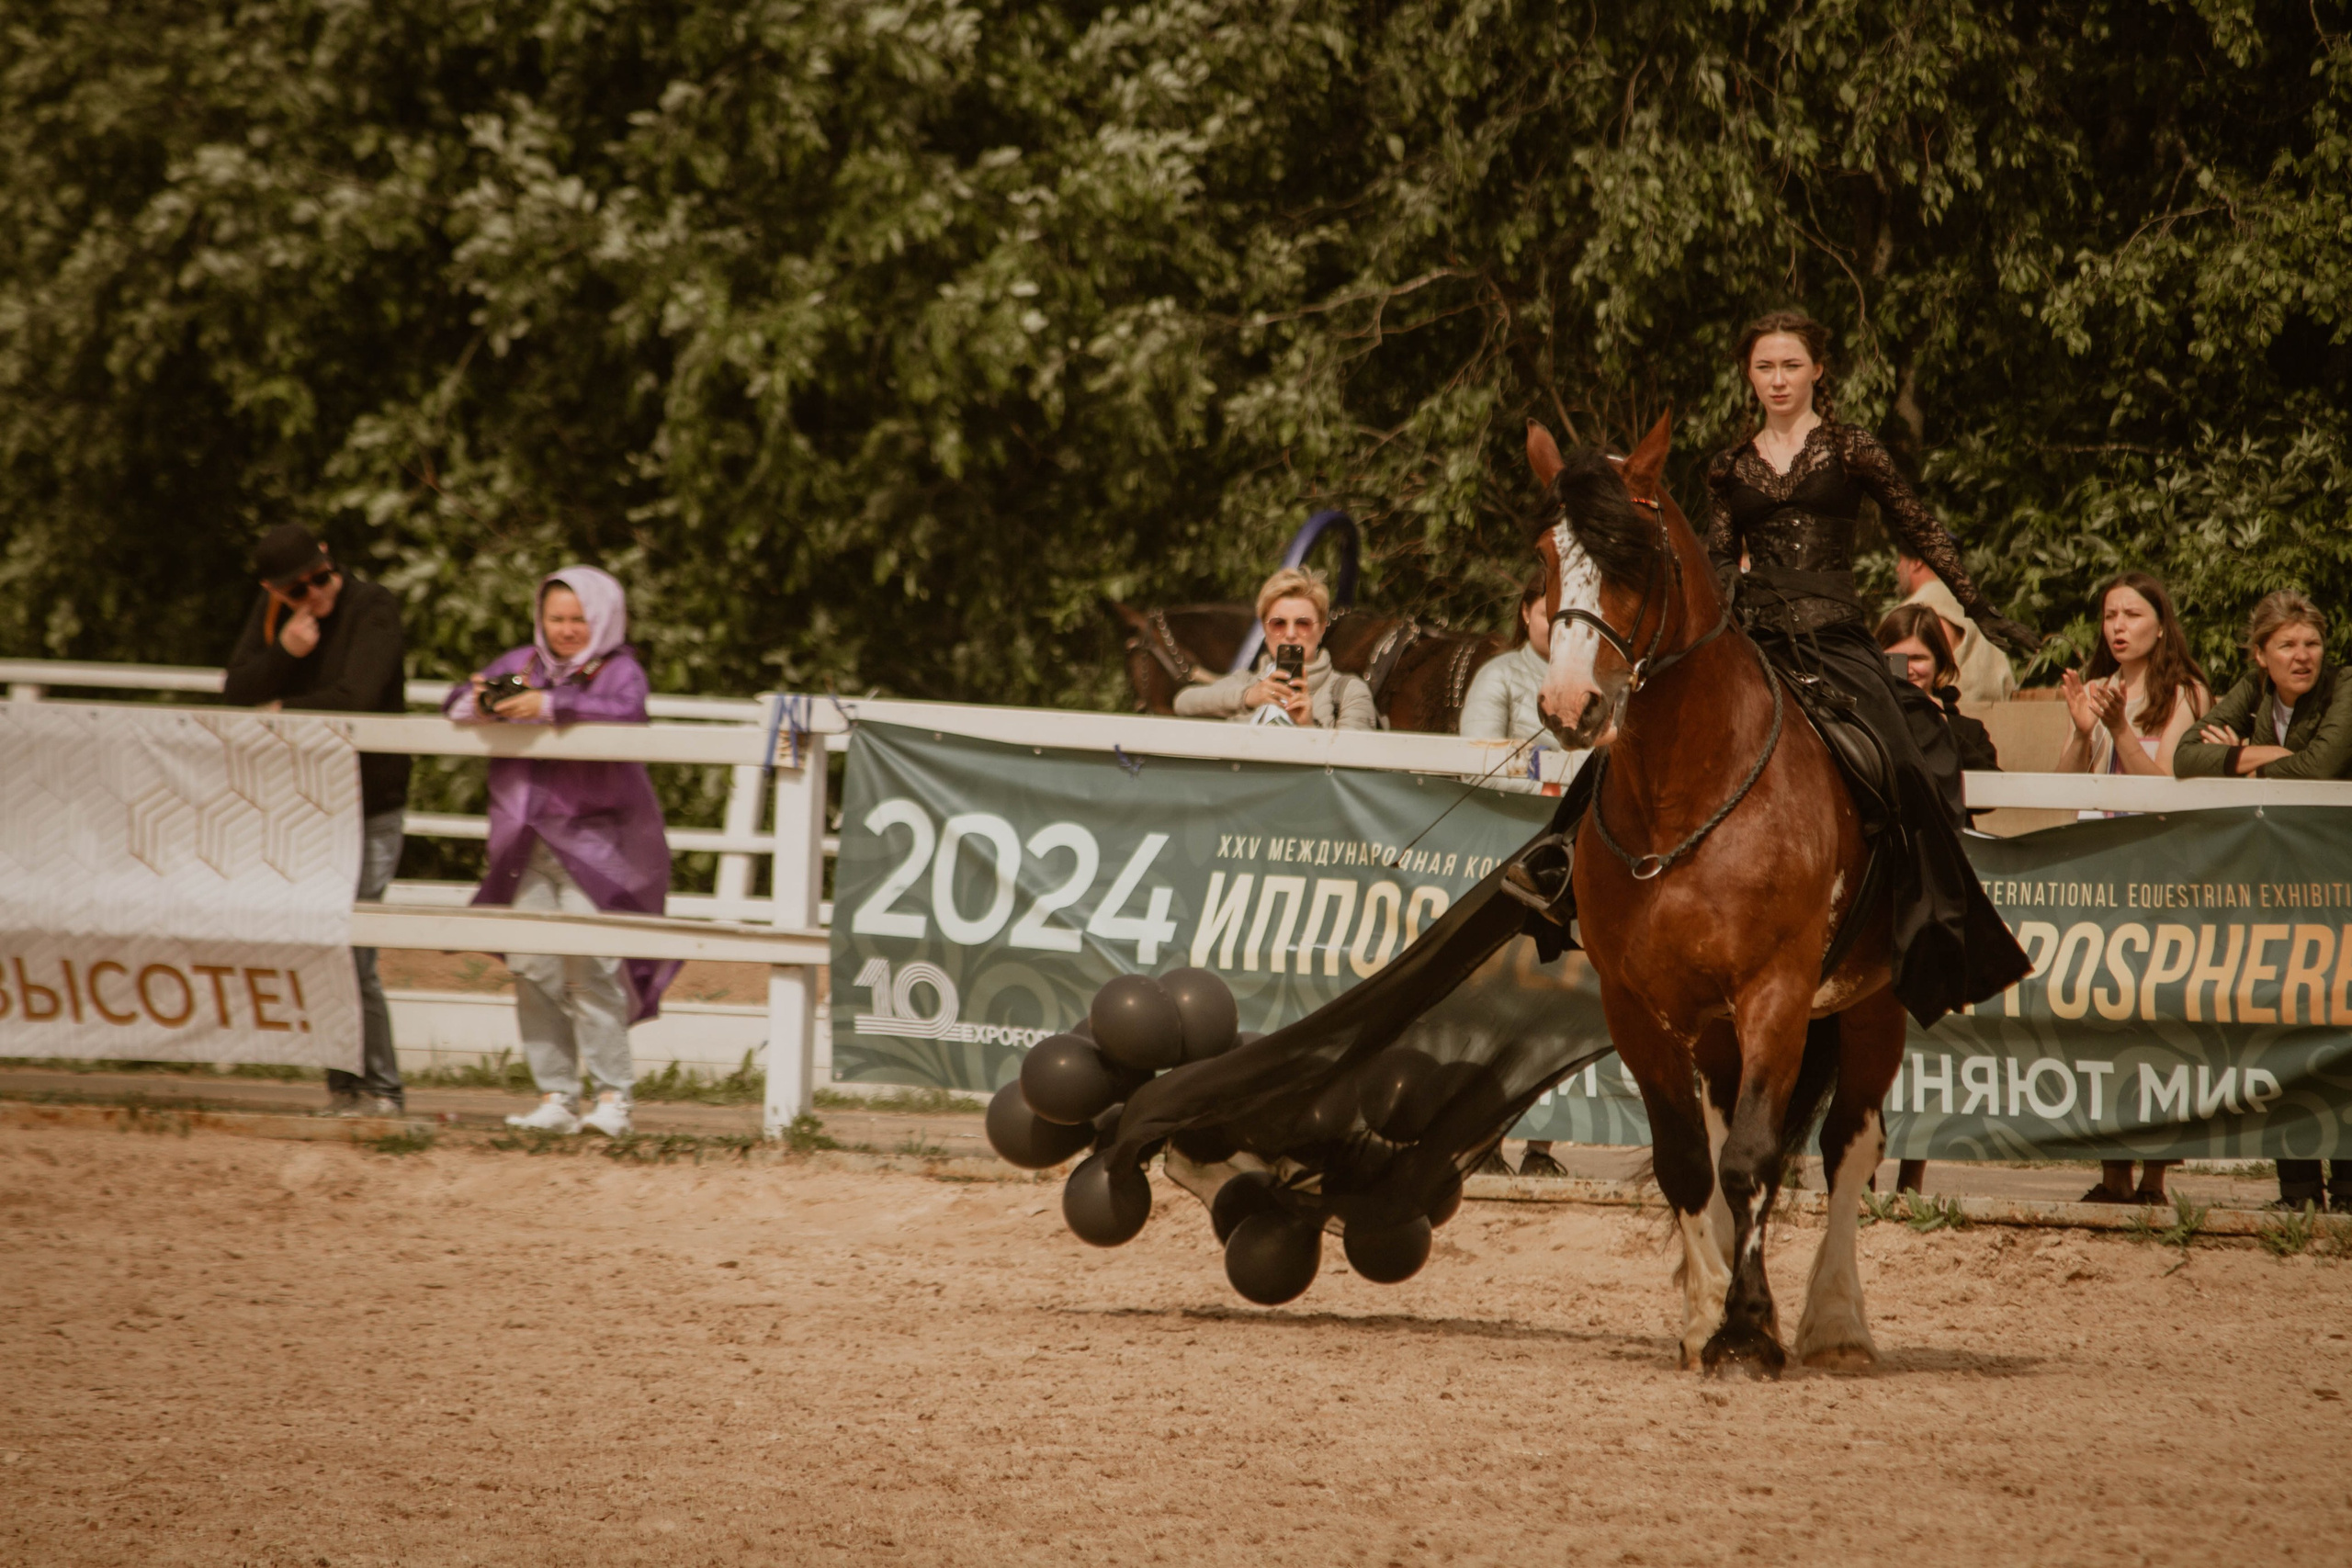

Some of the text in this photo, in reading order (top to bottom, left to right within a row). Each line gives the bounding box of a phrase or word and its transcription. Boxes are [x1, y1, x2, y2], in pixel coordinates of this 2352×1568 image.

[1269, 838, 1457, 875] МЕЖДУНАРОДНАЯ
[852, 798, 1177, 964] 2024
[1981, 881, 2119, 908] TERNATIONAL
[2128, 883, 2251, 908] EQUESTRIAN
[2139, 1062, 2284, 1122] МИР
